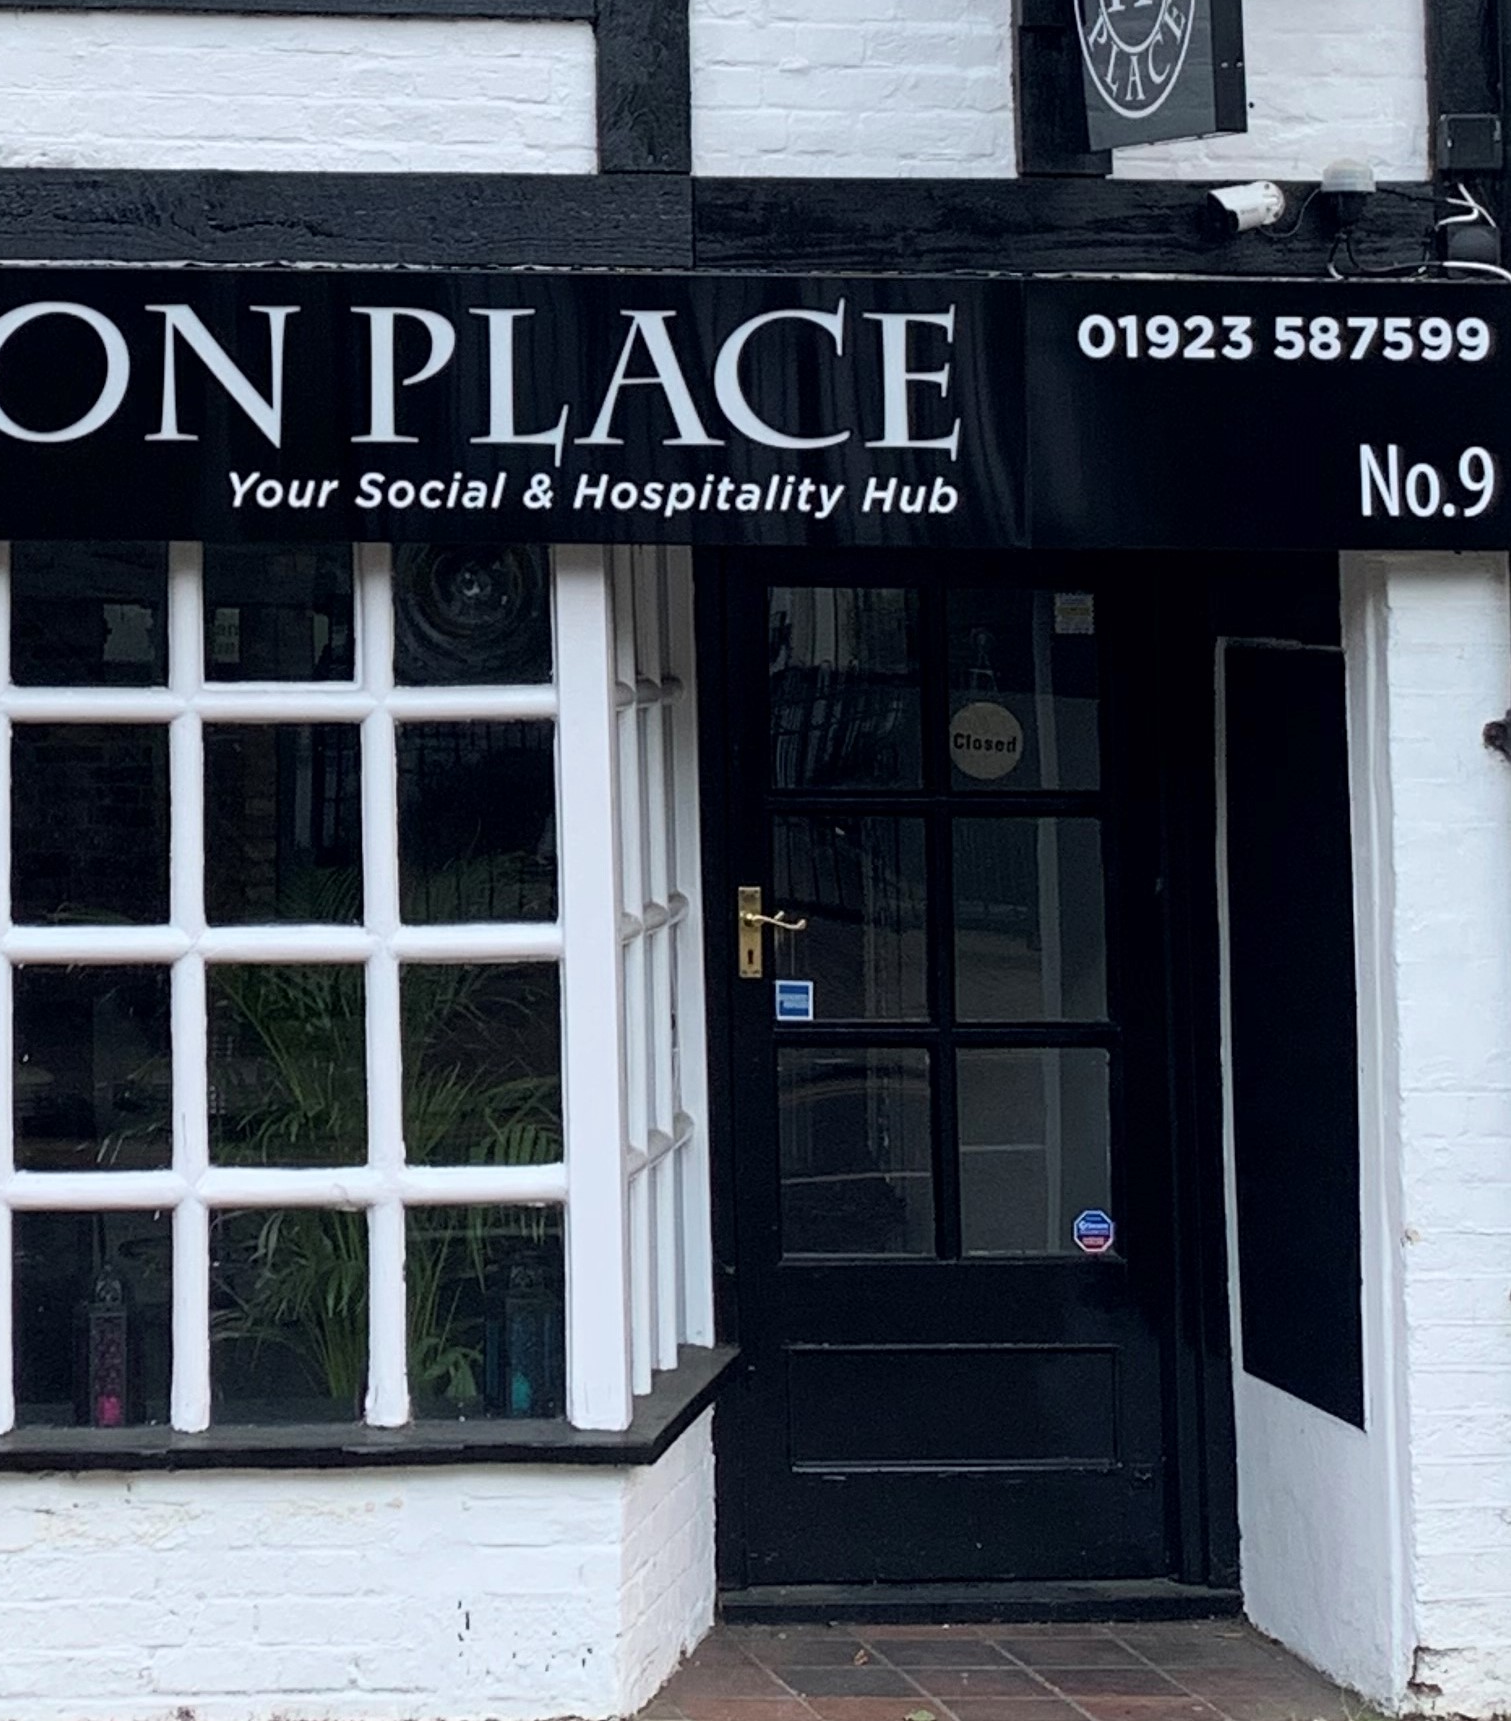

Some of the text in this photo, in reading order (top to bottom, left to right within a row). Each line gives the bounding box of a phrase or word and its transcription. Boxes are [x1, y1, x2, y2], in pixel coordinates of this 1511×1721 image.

[1078, 314, 1491, 362] 01923 587599
[350, 297, 961, 468] PLACE
[228, 471, 959, 519] Your Social & Hospitality Hub
[1359, 443, 1496, 518] No.9
[953, 732, 1017, 753] Closed
